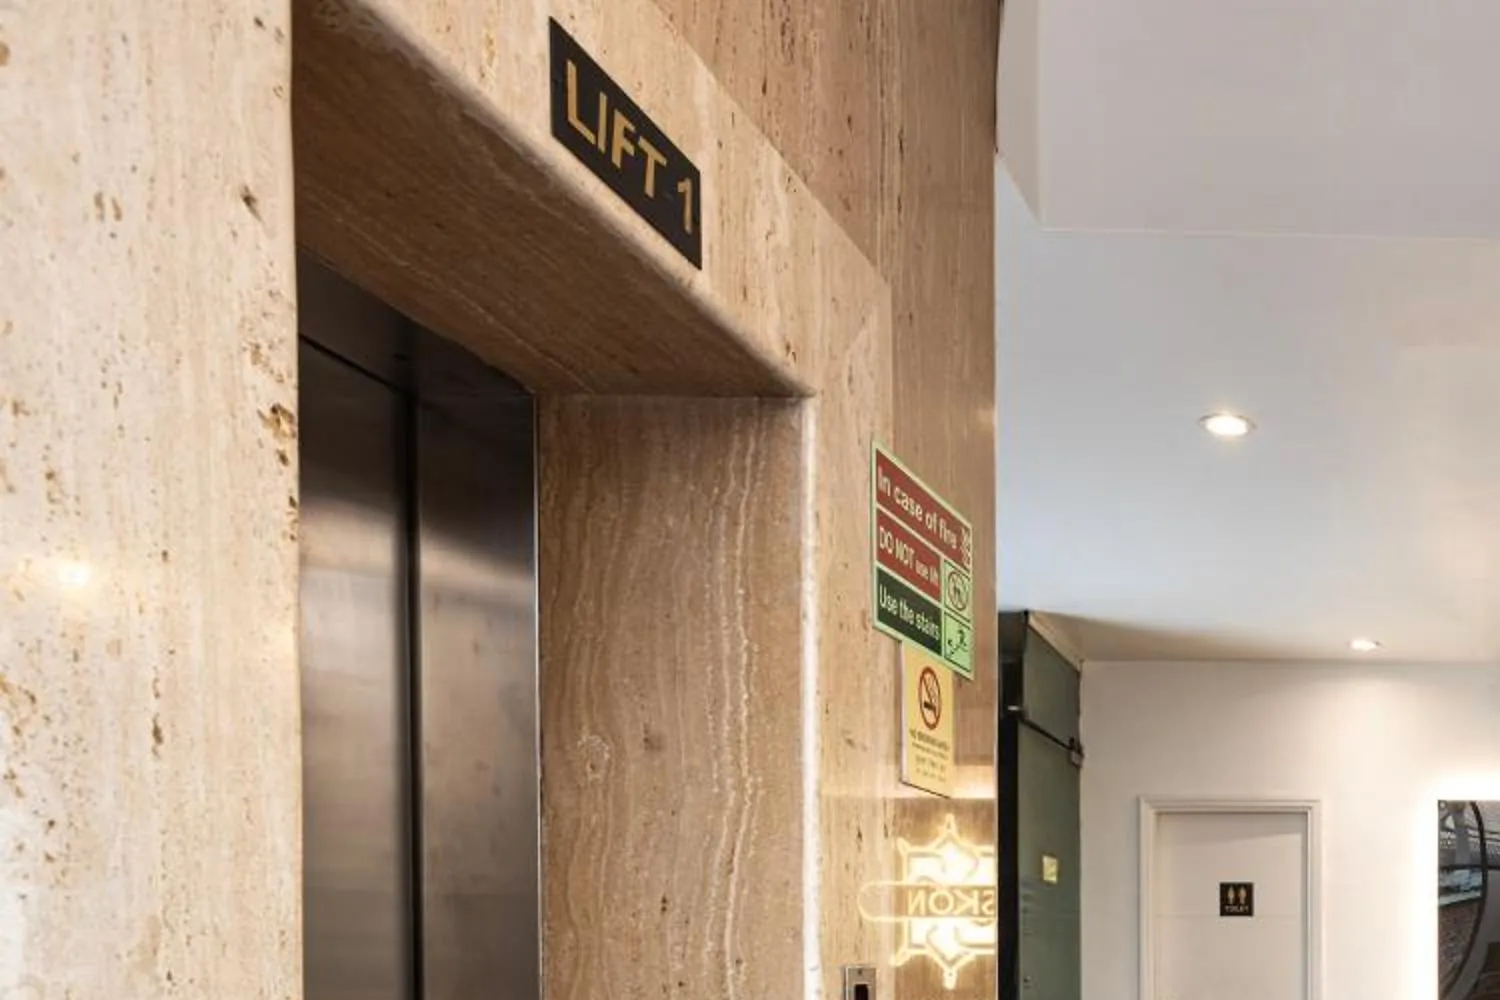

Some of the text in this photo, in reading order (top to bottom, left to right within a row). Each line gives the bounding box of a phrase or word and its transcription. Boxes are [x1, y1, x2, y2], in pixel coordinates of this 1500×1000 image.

[566, 58, 694, 236] LIFT 1
[877, 464, 958, 550] In case of fire
[879, 525, 894, 555] DO
[895, 536, 915, 569] NOT
[879, 582, 941, 641] Use the stairs
